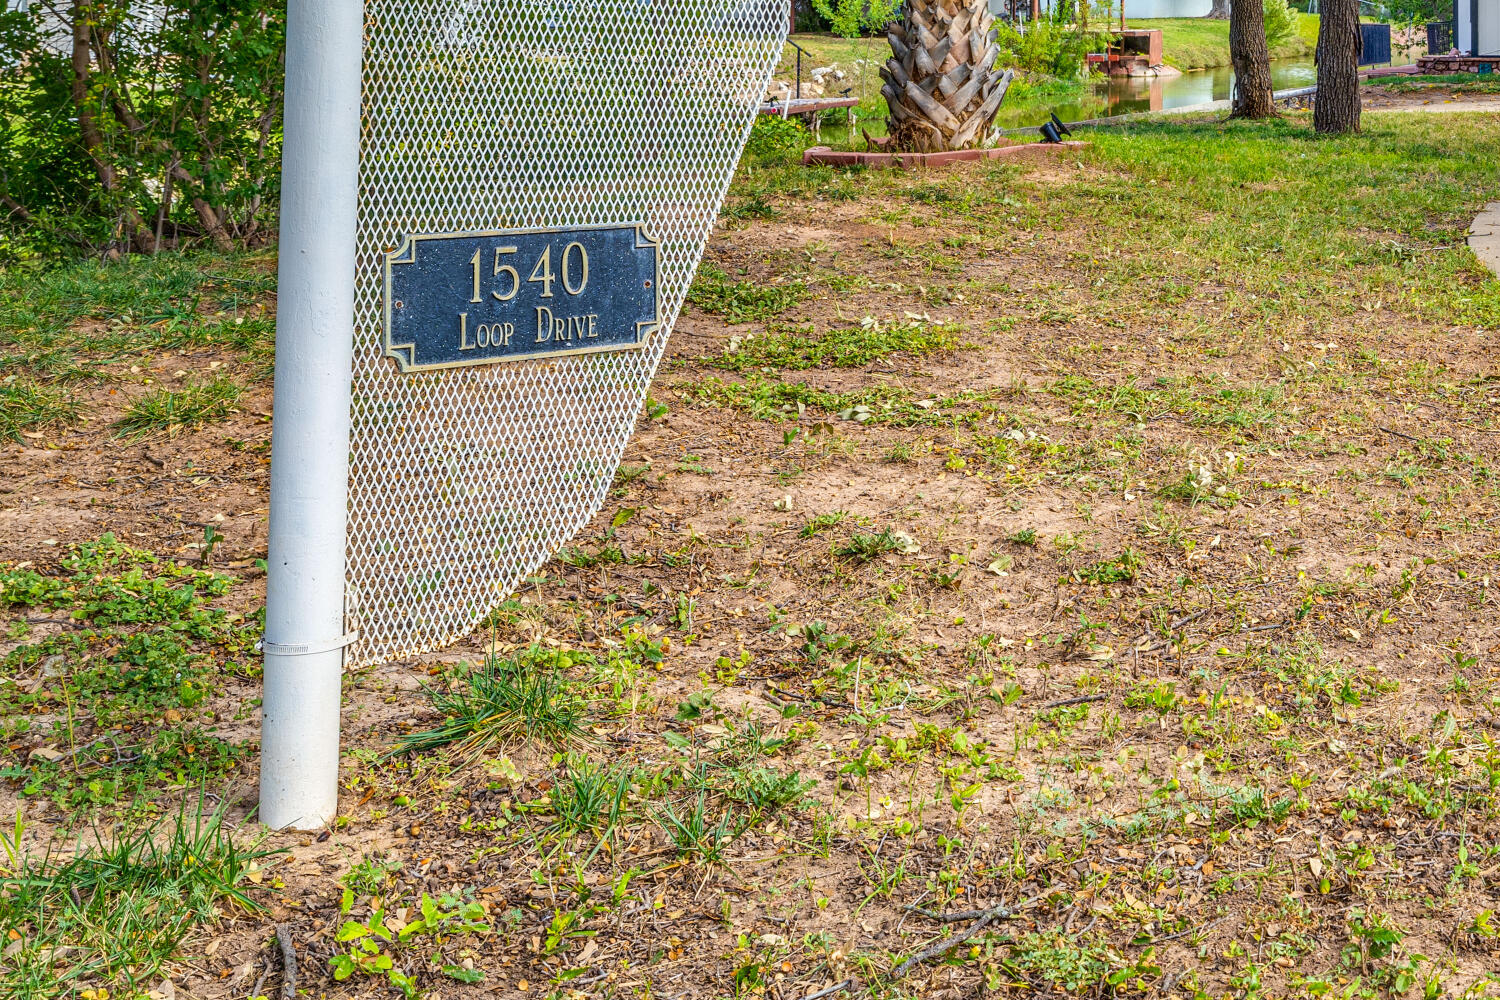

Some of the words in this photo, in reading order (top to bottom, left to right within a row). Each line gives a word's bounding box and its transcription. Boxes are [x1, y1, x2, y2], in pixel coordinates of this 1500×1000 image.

[470, 242, 589, 303] 1540
[459, 313, 514, 351] LOOP
[535, 306, 598, 343] DRIVE
